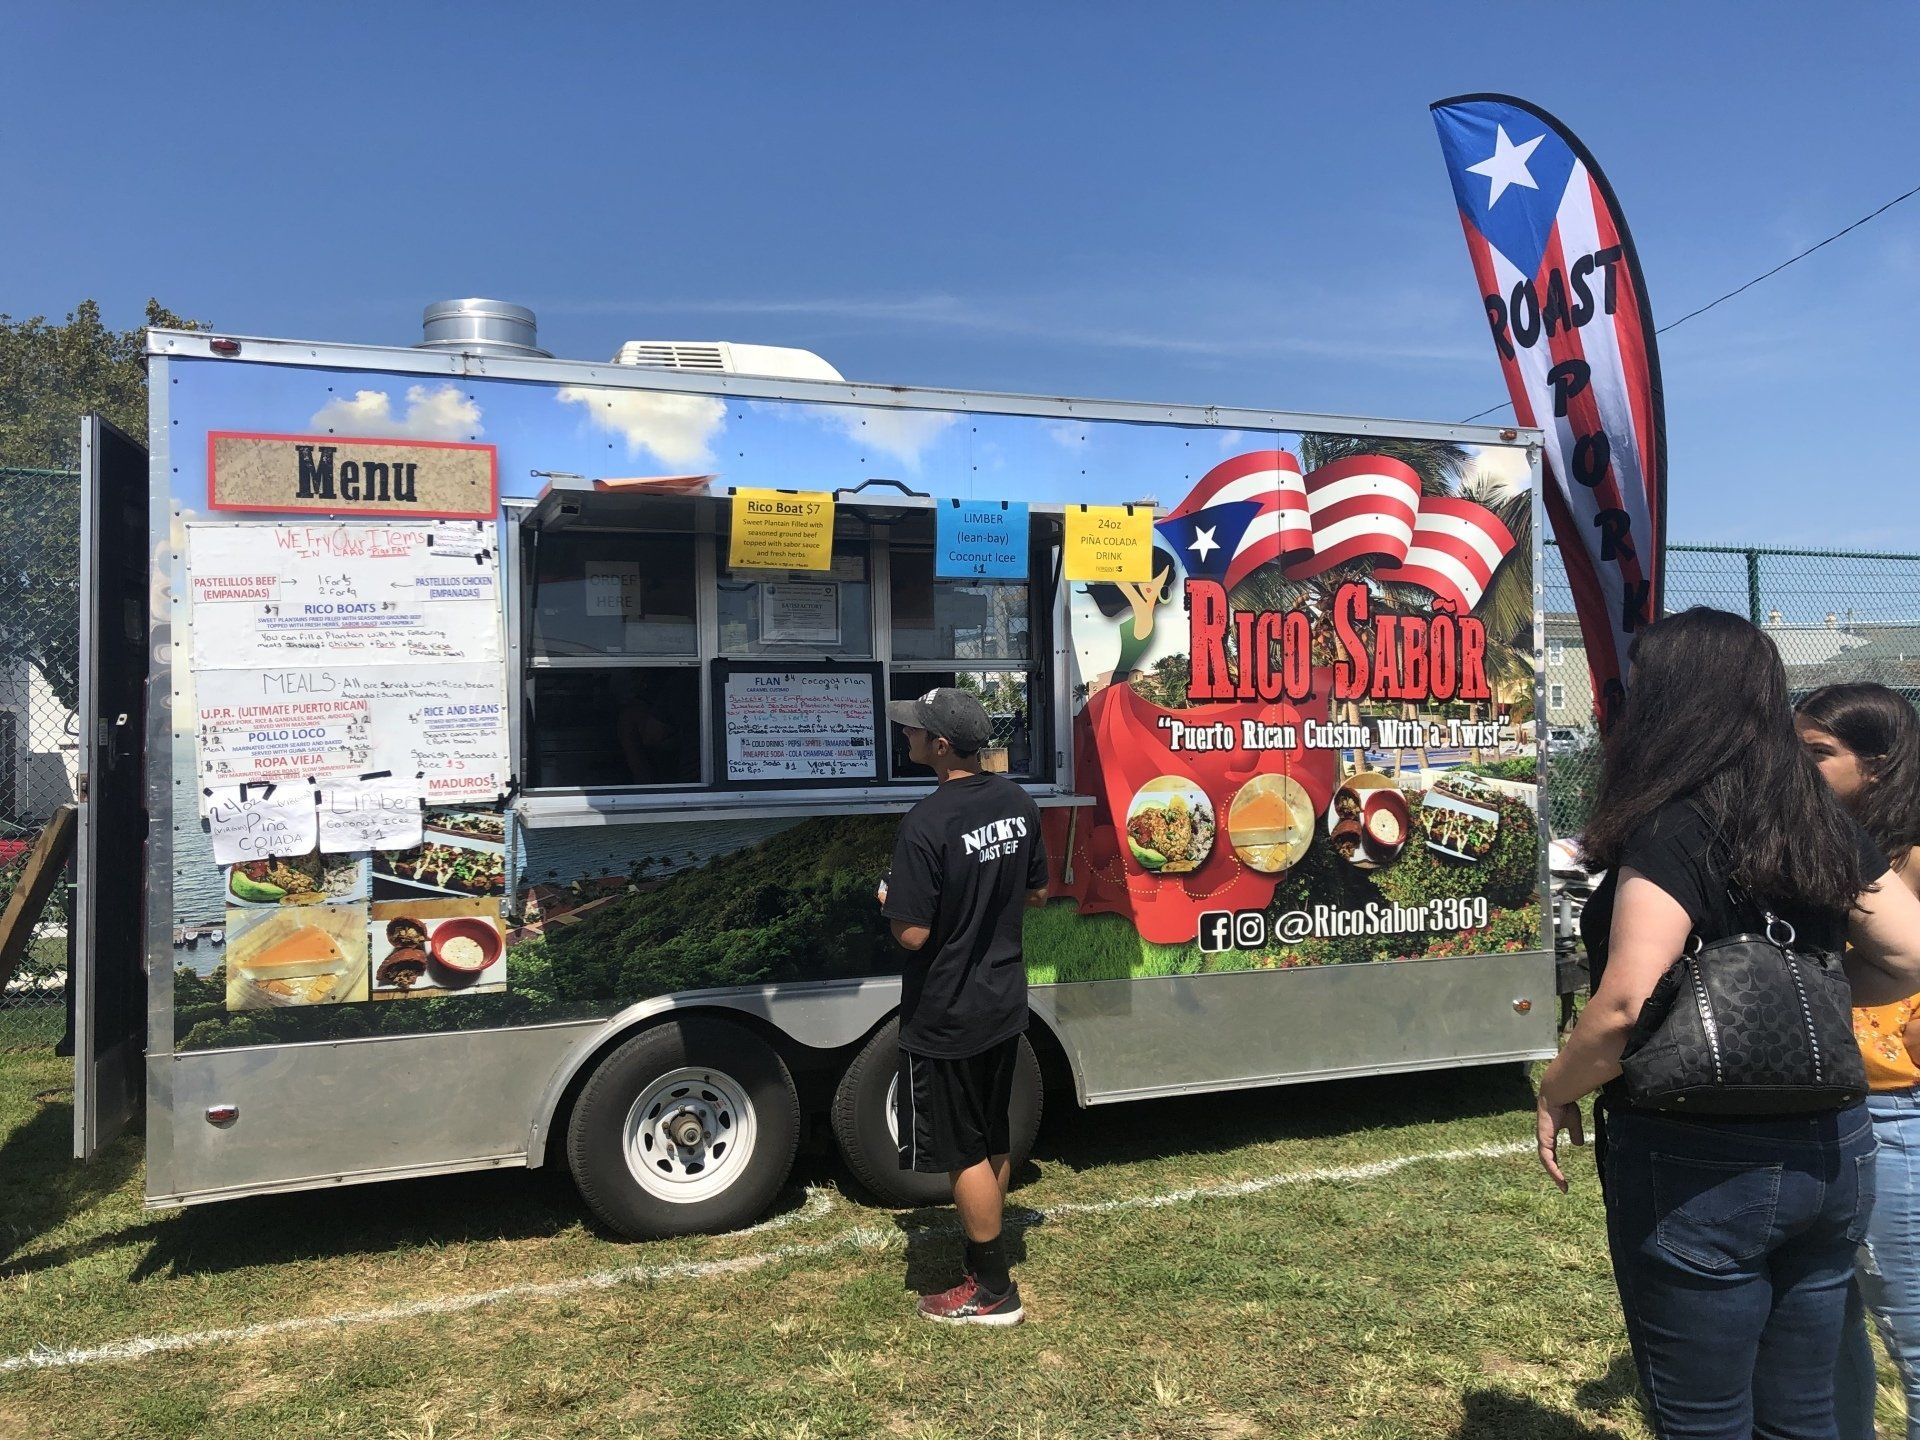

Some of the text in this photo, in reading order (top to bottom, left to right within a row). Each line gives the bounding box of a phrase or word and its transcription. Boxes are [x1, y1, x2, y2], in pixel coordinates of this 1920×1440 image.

[1483, 245, 1622, 361] ROAST
[295, 445, 418, 503] Menu
[1546, 359, 1651, 633] PORK
[748, 501, 821, 516] Rico Boat $7
[764, 519, 790, 527] Plantain
[791, 520, 808, 528] Filled
[964, 513, 1004, 524] LIMBER
[1098, 519, 1122, 530] 24oz
[306, 528, 331, 552] Fry
[332, 526, 366, 550] Our
[748, 529, 778, 537] seasoned
[779, 530, 802, 539] ground
[957, 532, 1009, 546] (lean-bay)
[1080, 533, 1138, 546] PIÑA COLADA
[743, 540, 767, 548] topped
[297, 550, 320, 559] IN
[949, 551, 1016, 563] Coconut Icee
[1096, 551, 1122, 561] DRINK
[194, 576, 277, 587] PASTELILLOS BEEF
[415, 576, 493, 587] PASTELILLOS CHICKEN
[203, 588, 270, 600] (EMPANADAS)
[429, 588, 481, 598] (EMPANADAS)
[304, 603, 376, 614] RICO BOATS
[597, 596, 633, 609] HERE
[262, 672, 336, 695] MEALS
[755, 676, 781, 686] FLAN
[201, 699, 368, 720] U.P.R. (ULTIMATE PUERTO RICAN)
[423, 704, 500, 717] RICE AND BEANS
[248, 728, 326, 742] POLLO LOCO
[1241, 717, 1297, 752] Rican
[1303, 720, 1371, 751] Cuisine
[1377, 716, 1429, 750] With
[1429, 727, 1442, 749] a
[231, 744, 265, 752] MARINATED
[751, 740, 766, 748] COLD
[766, 740, 785, 748] DRINKS
[742, 750, 770, 758] PINEAPPLE
[770, 750, 785, 758] SODA
[788, 750, 802, 758] COLA
[803, 749, 834, 757] CHAMPAGNE
[837, 749, 854, 757] MALTA
[254, 754, 325, 768] ROPA VIEJA
[429, 776, 491, 789] MADUROS
[961, 816, 1027, 856] NICK'S
[979, 844, 1001, 863] OAST
[1274, 896, 1489, 945] @RicoSabor3369
